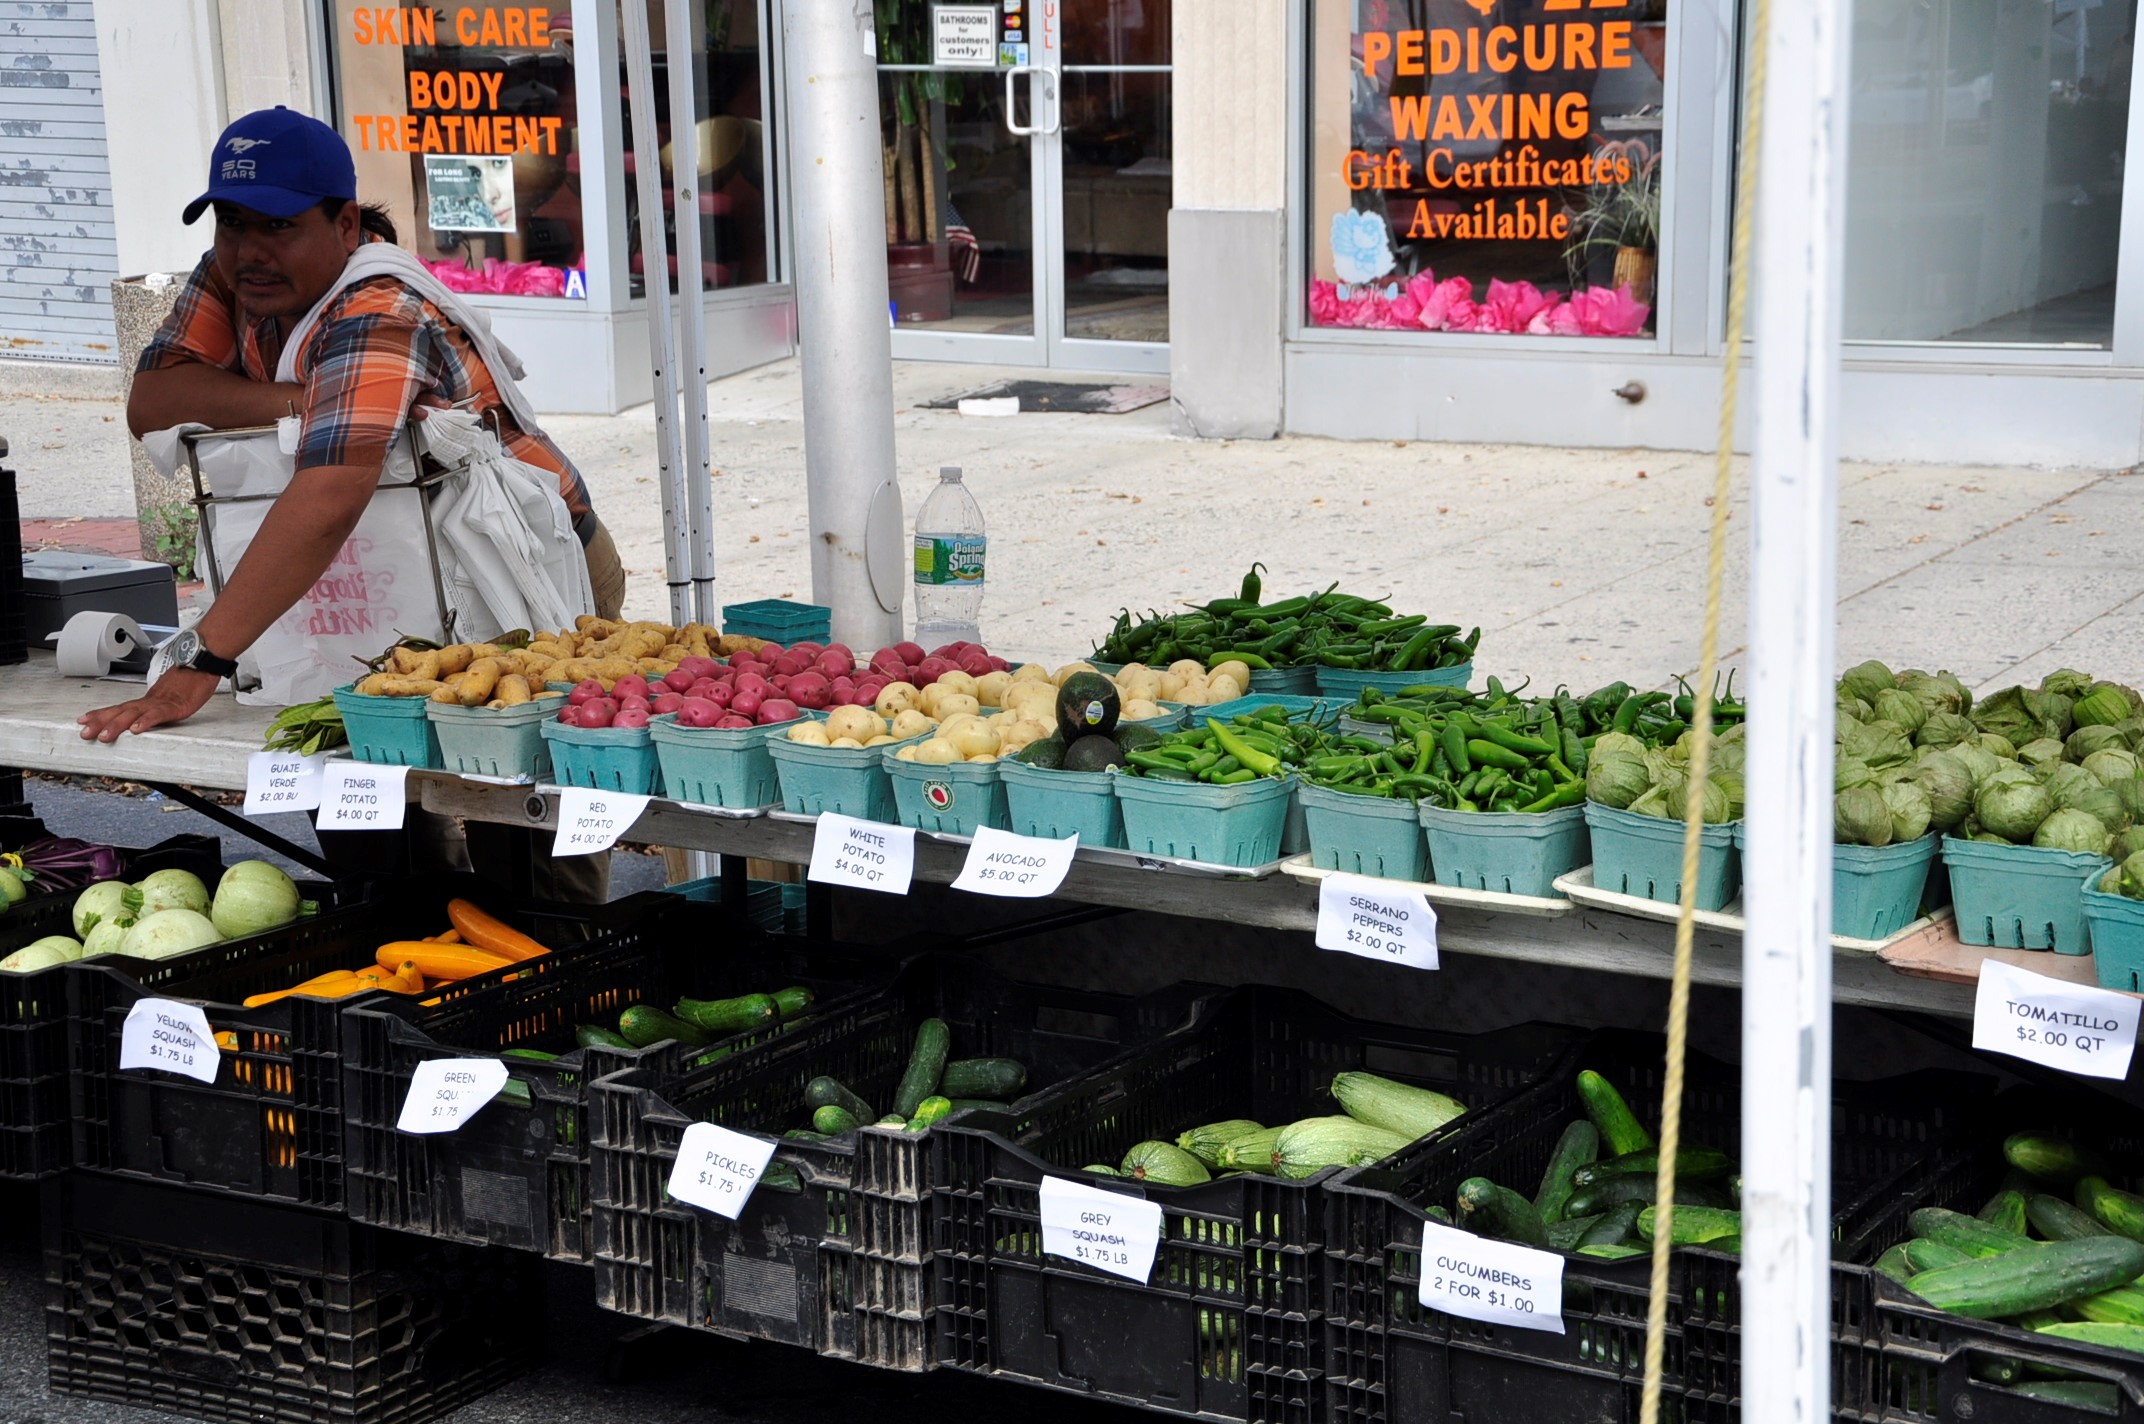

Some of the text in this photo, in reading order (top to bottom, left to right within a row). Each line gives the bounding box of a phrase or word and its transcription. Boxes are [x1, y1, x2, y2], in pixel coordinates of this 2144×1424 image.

[353, 8, 550, 46] SKIN CARE
[940, 16, 988, 24] BATHROOMS
[940, 36, 989, 44] customers
[1363, 22, 1632, 77] PEDICURE
[410, 71, 503, 110] BODY
[1390, 92, 1589, 140] WAXING
[354, 115, 561, 155] TREATMENT
[221, 170, 256, 180] YEARS
[222, 159, 255, 171] 50
[428, 168, 463, 176] FOR LONG
[1342, 145, 1630, 190] Gift Certificates
[1407, 198, 1568, 239] Available
[954, 541, 984, 554] Poland
[948, 552, 985, 571] Spring
[270, 763, 300, 774] GUAJE
[270, 778, 297, 788] VERDE
[344, 778, 376, 788] FINGER
[259, 792, 298, 802] $2.00 BU
[340, 794, 377, 804] POTATO
[336, 810, 379, 820] $4.00 QT
[589, 802, 606, 813] RED
[576, 818, 614, 829] POTATO
[850, 827, 885, 848] WHITE
[843, 843, 885, 865] POTATO
[986, 852, 1046, 868] AVOCADO
[835, 859, 884, 882] $4.00 QT
[979, 868, 1038, 884] $5.00 QT
[1349, 896, 1409, 921] SERRANO
[1353, 913, 1403, 936] PEPPERS
[1346, 928, 1406, 955] $2.00 QT
[2006, 1000, 2118, 1032] TOMATILLO
[152, 1030, 196, 1050] SQUASH
[2016, 1025, 2106, 1053] $2.00 QT
[150, 1044, 194, 1066] $1.75 LB
[444, 1072, 476, 1084] GREEN
[706, 1151, 756, 1179] PICKLES
[698, 1170, 734, 1194] $1.75
[1080, 1212, 1111, 1226] GREY
[1072, 1230, 1126, 1246] SQUASH
[1076, 1245, 1128, 1265] $1.75 LB
[1437, 1256, 1532, 1291] CUCUMBERS
[1434, 1276, 1534, 1314] 2 FOR $1.00
